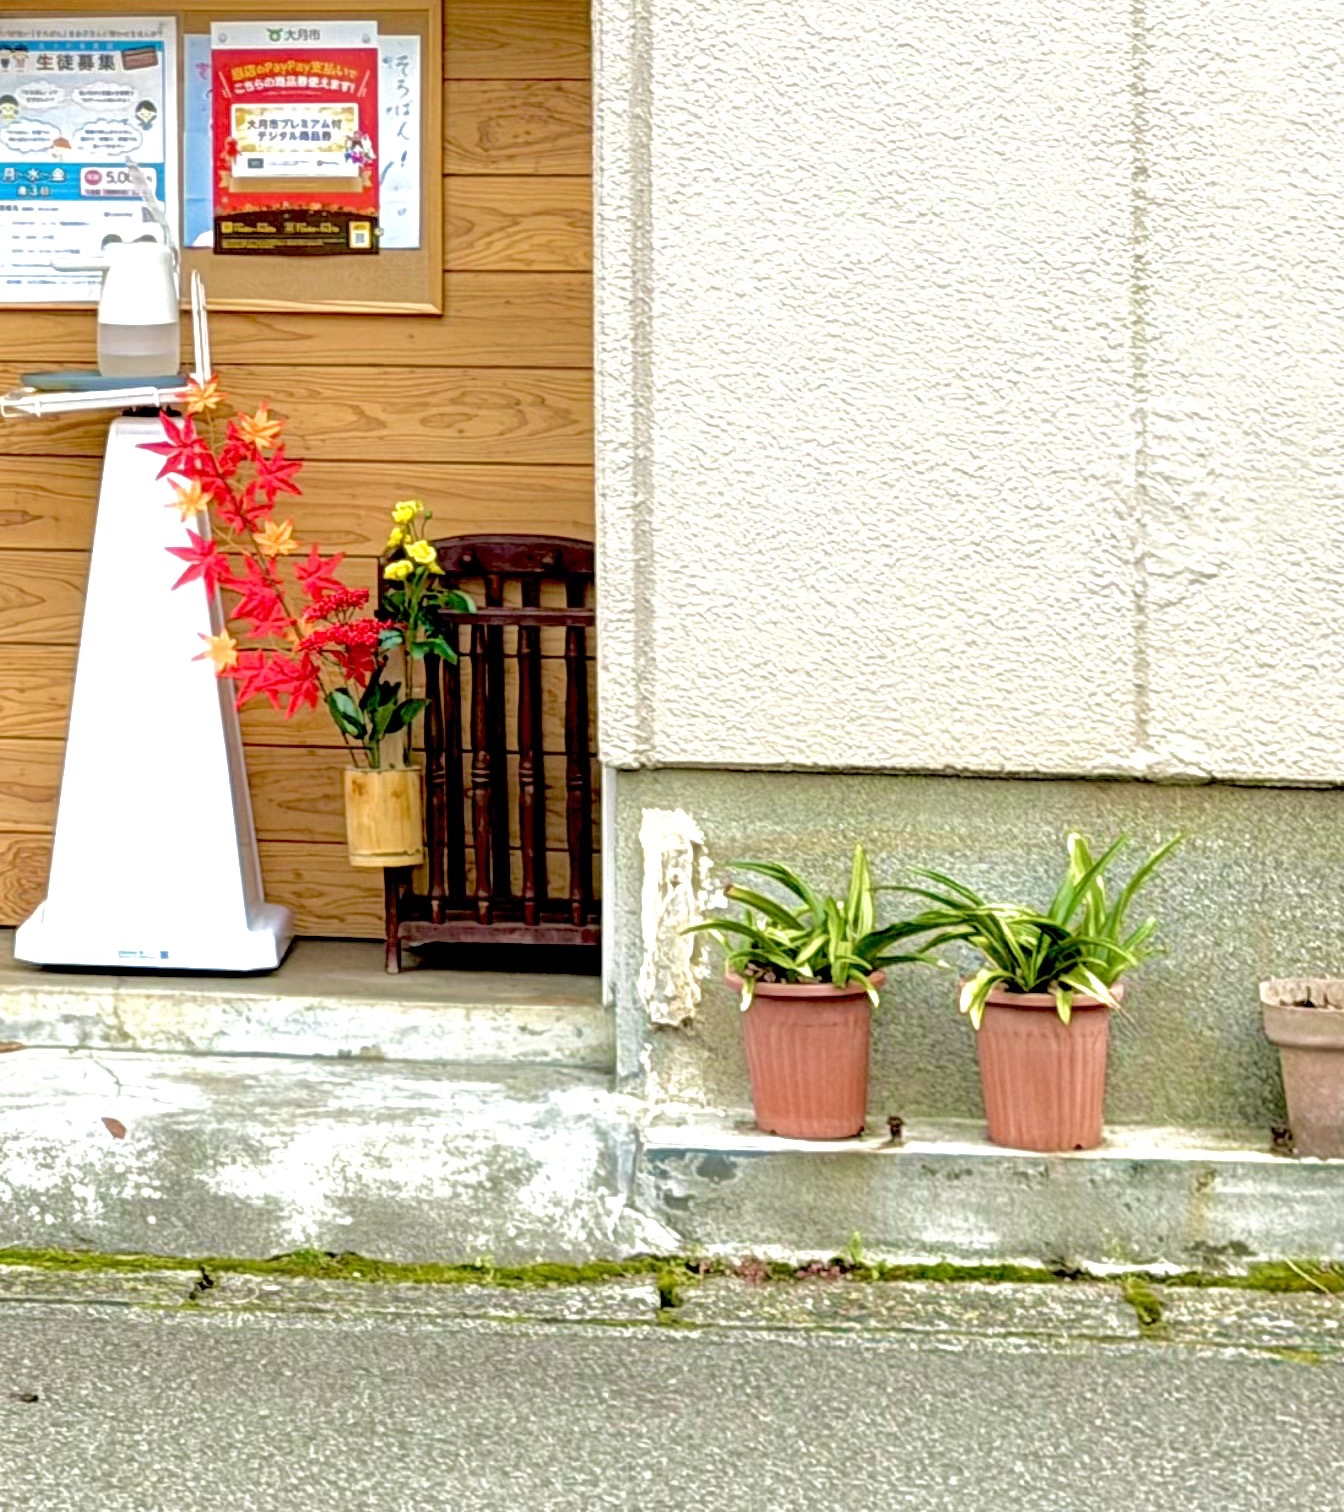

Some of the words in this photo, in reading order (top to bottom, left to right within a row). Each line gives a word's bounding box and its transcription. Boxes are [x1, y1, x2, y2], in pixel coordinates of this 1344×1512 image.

[285, 29, 321, 42] 大月市
[35, 54, 116, 71] 生徒募集
